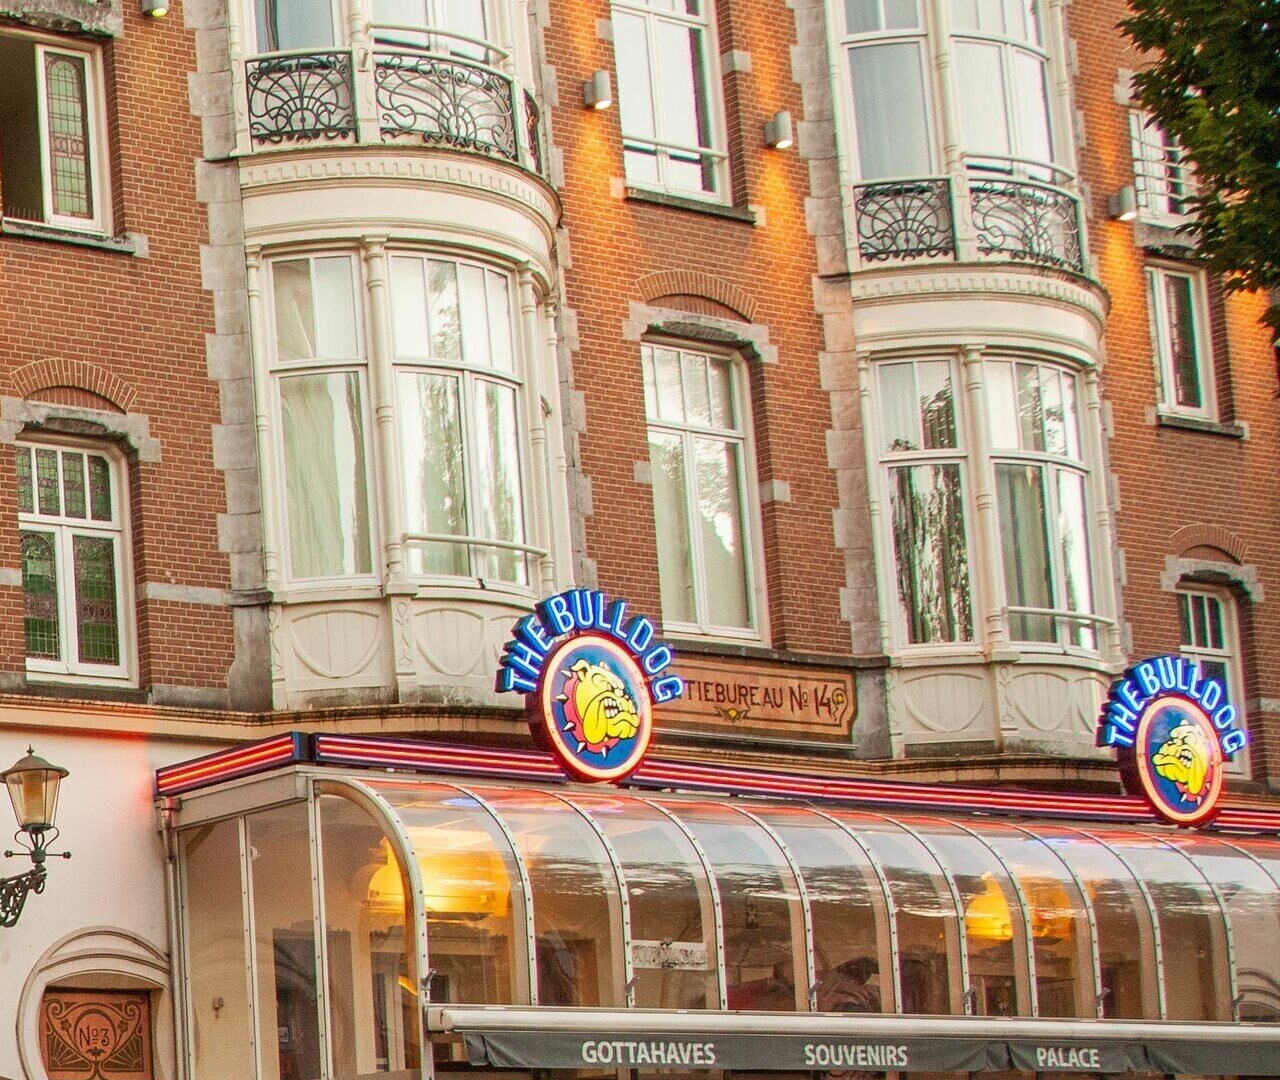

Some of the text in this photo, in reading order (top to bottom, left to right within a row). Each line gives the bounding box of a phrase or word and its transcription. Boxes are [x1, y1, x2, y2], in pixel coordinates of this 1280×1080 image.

[508, 589, 685, 703] THE BULLDOG
[684, 680, 784, 709] TIEBUREAU
[1107, 655, 1247, 754] THE BULLDOG
[101, 1027, 110, 1047] 3
[580, 1040, 717, 1067] GOTTAHAVES
[803, 1043, 909, 1068] SOUVENIRS
[1035, 1045, 1101, 1070] PALACE
